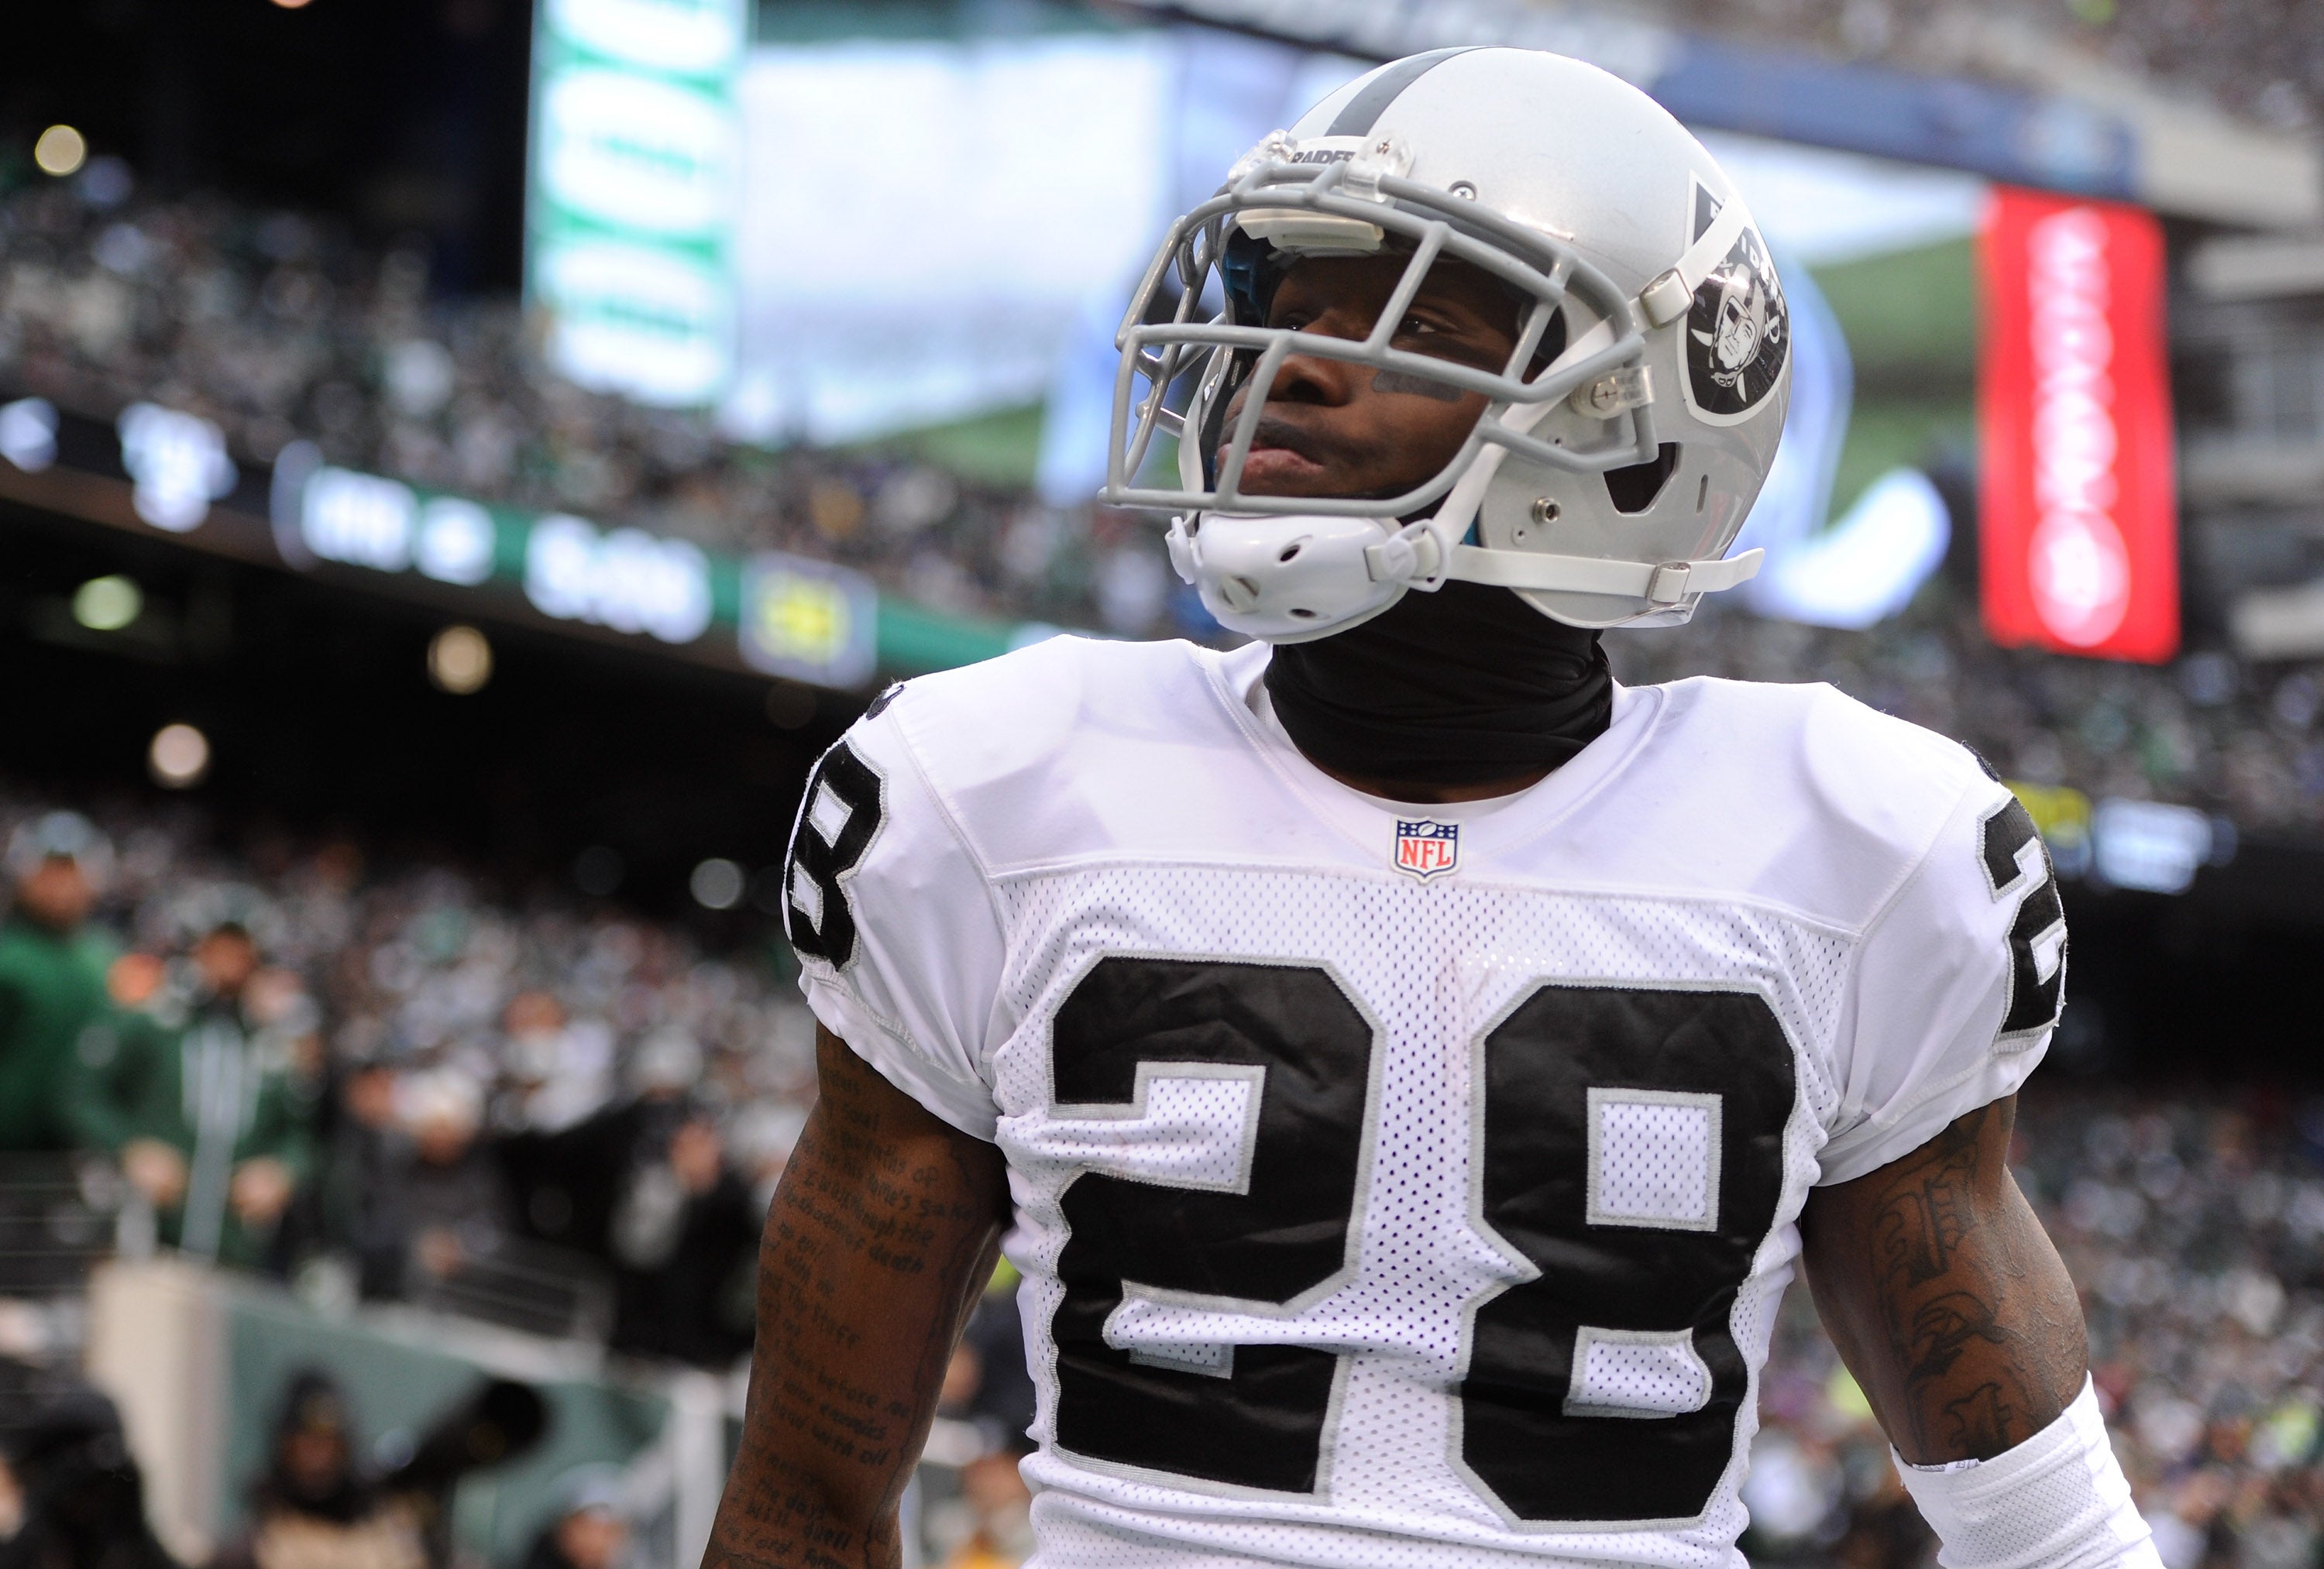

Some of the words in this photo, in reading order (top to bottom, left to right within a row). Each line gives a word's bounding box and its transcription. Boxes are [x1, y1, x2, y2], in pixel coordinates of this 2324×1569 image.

[1291, 149, 1357, 165] RAIDER
[1400, 839, 1452, 870] NFL
[1048, 950, 1803, 1533] 28
